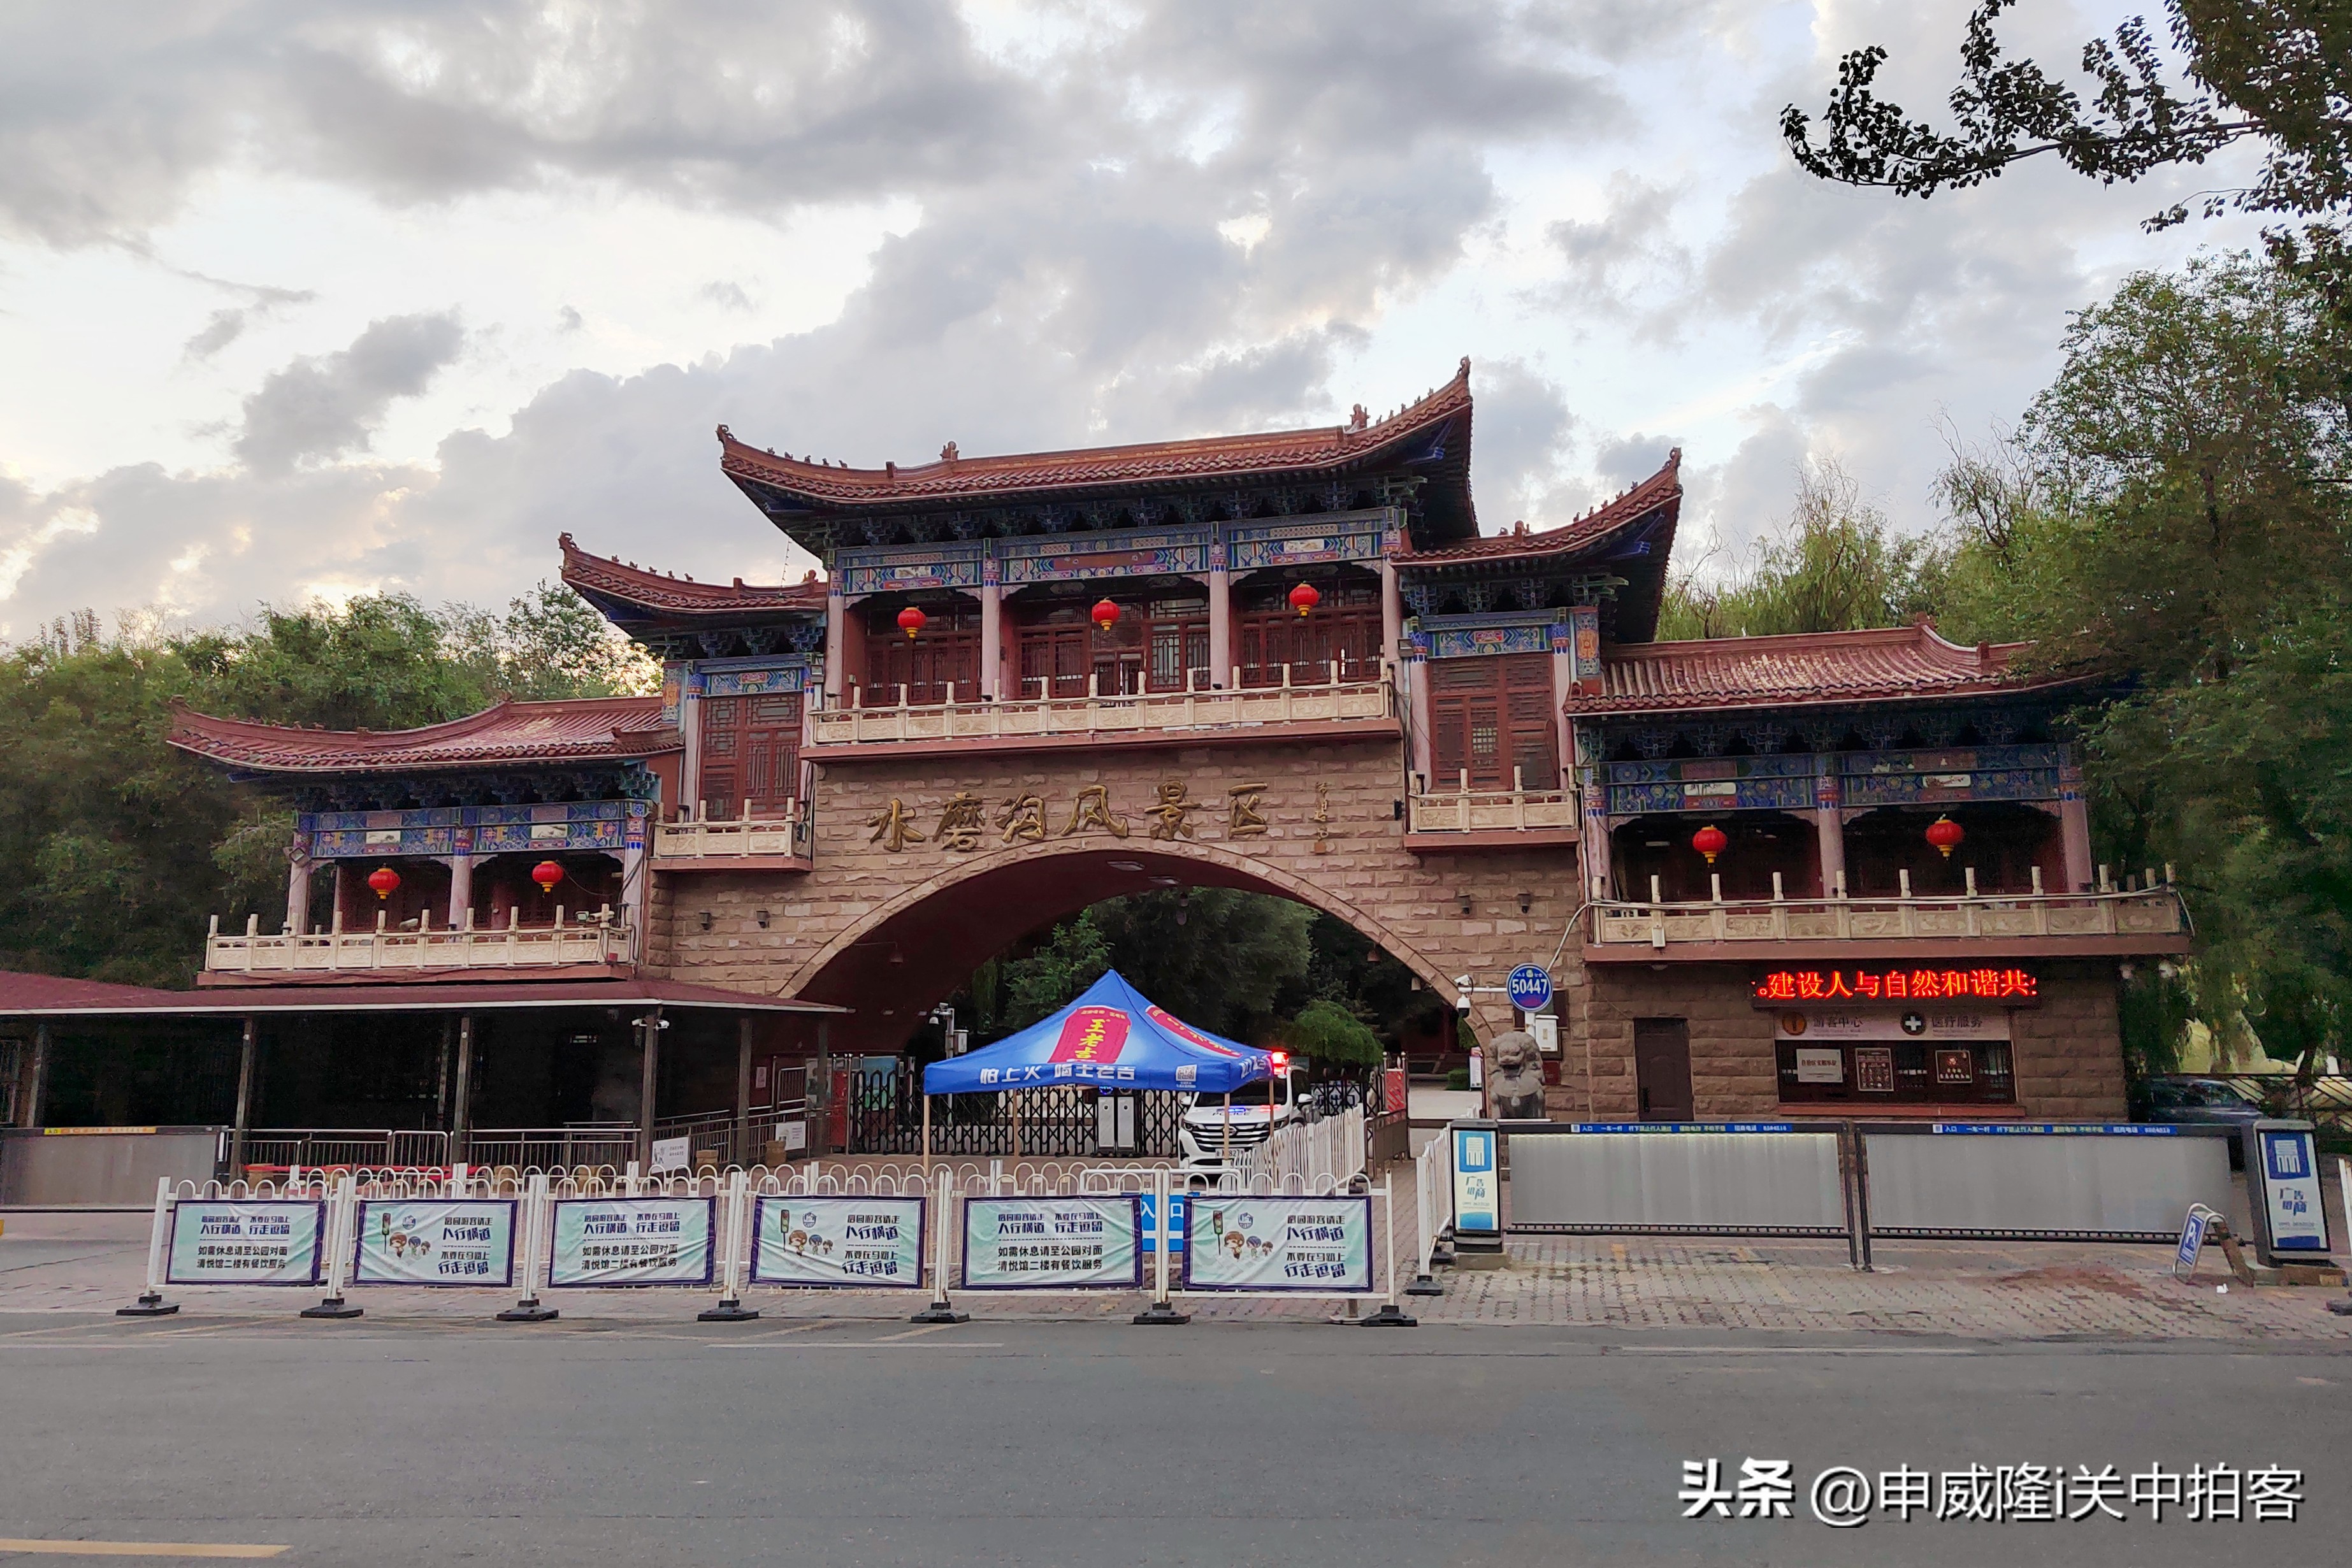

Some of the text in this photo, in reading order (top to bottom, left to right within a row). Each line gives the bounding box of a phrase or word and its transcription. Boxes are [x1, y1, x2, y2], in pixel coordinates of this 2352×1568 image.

[867, 781, 1268, 852] 水磨沟风景区
[1512, 979, 1547, 994] 50447
[1074, 1019, 1106, 1059] 王老吉
[980, 1065, 1043, 1084] 怕上火
[1141, 1201, 1183, 1218] 入口
[200, 1224, 241, 1235] 人行横道
[442, 1227, 491, 1241] 人行横道
[584, 1223, 627, 1234] 人行横道
[846, 1225, 898, 1240] 人行横道
[998, 1222, 1045, 1234] 人行横道
[1287, 1226, 1345, 1242] 人行横道
[198, 1246, 287, 1256] 如需休息请至公园对面
[582, 1244, 679, 1256] 如需休息请至公园对面
[998, 1244, 1103, 1257] 如需休息请至公园对面
[438, 1260, 489, 1275] 行走逗留
[842, 1260, 898, 1276] 行走逗留
[1284, 1262, 1346, 1278] 行走逗留
